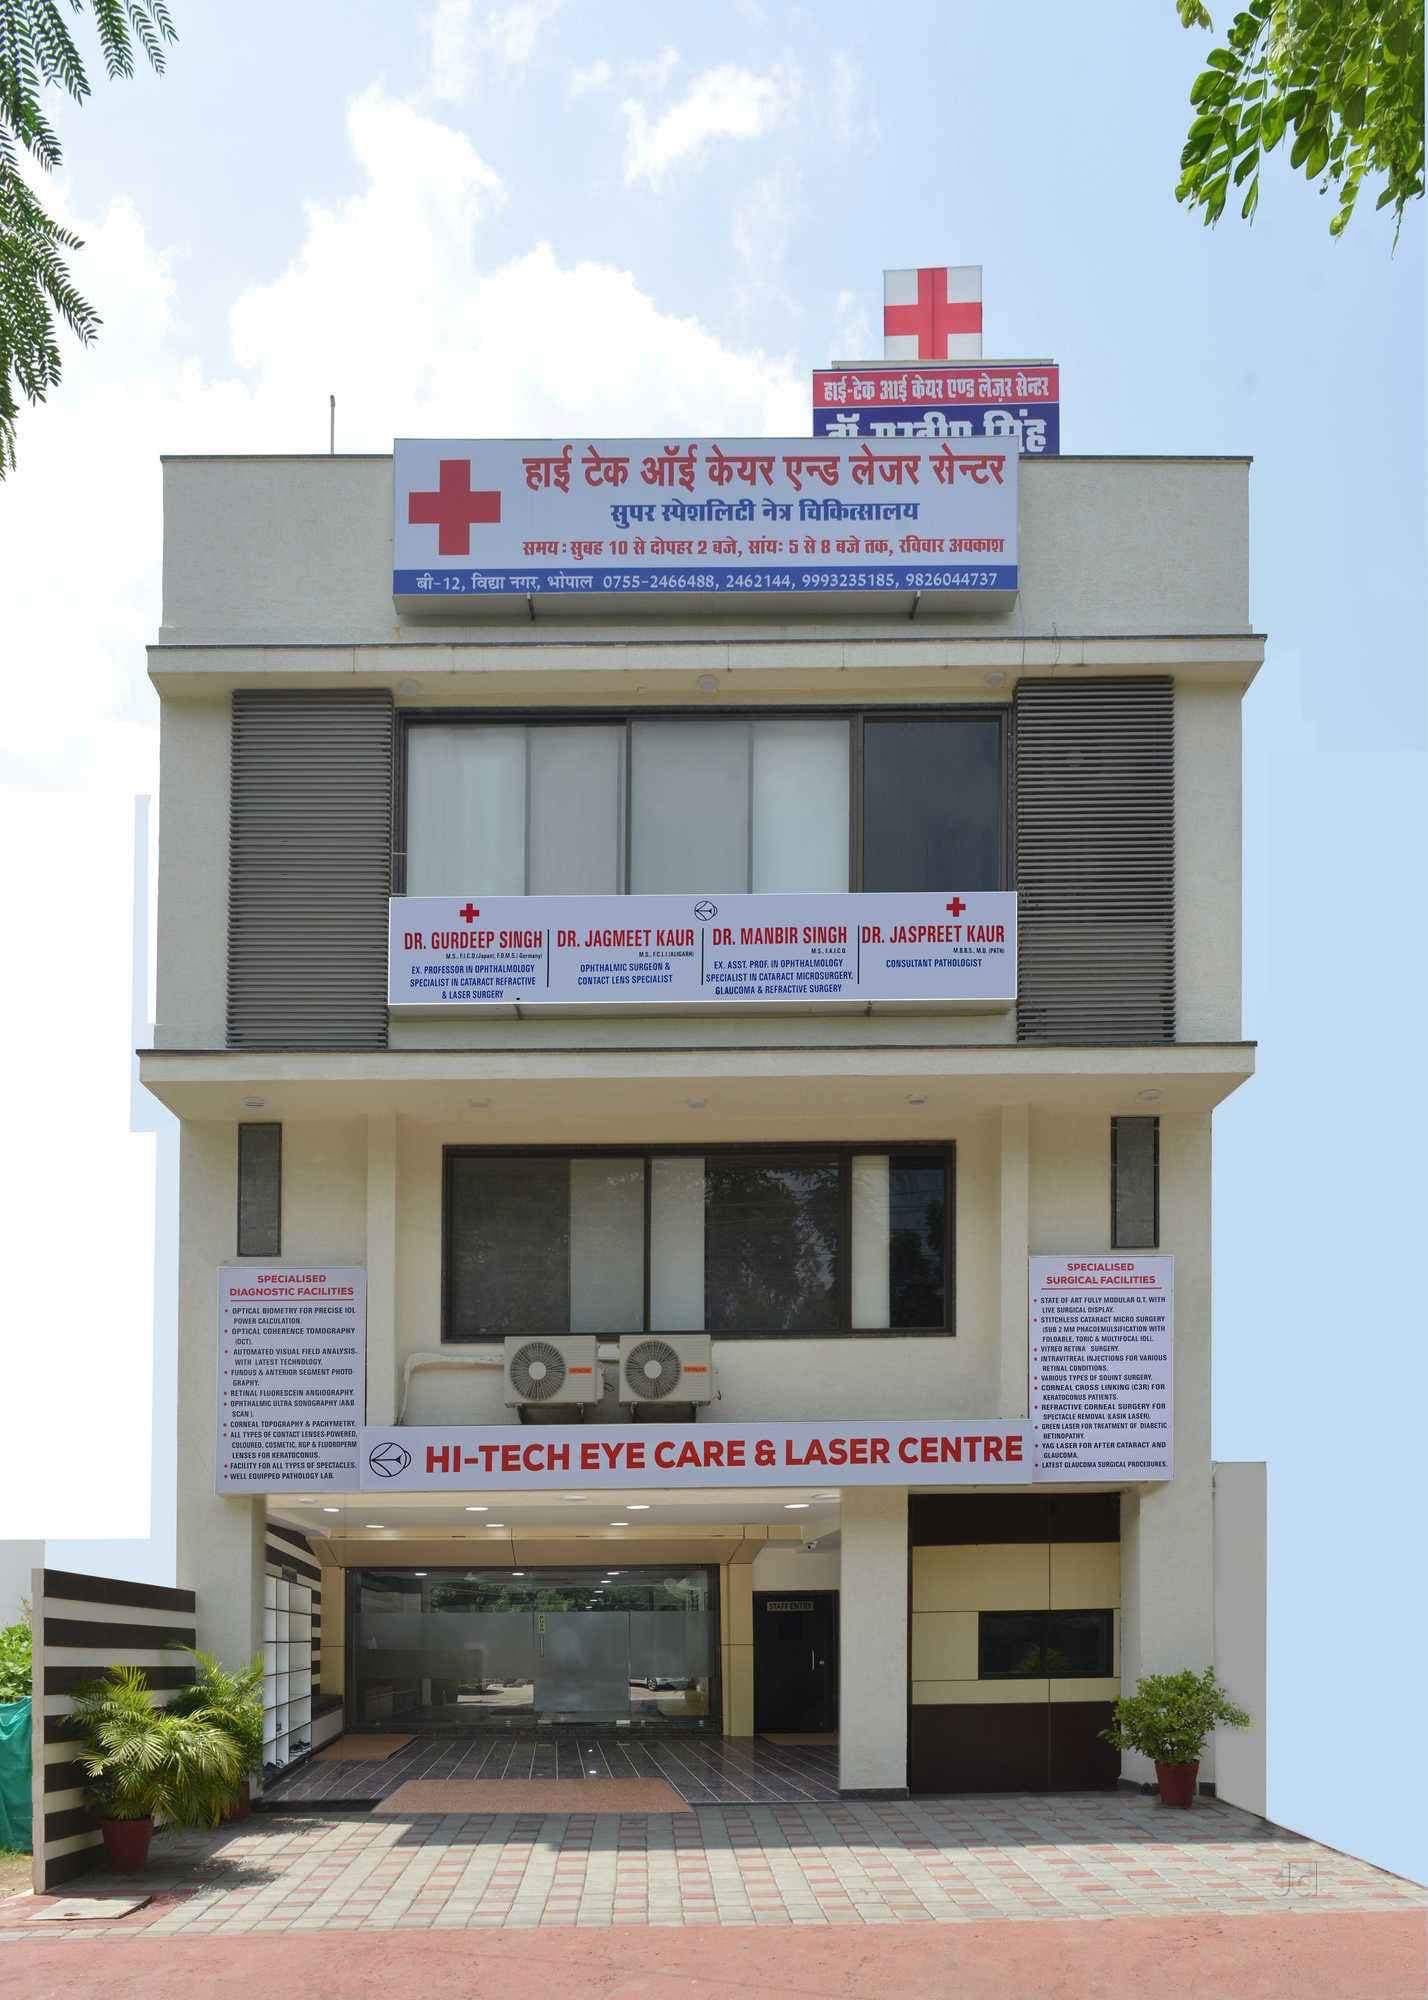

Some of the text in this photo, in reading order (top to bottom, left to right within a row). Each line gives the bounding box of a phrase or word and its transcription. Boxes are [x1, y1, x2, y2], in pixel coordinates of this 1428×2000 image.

[880, 375, 908, 401] आई
[911, 374, 944, 399] केयर
[1016, 373, 1049, 397] सेन्टर
[522, 442, 1006, 492] हाई टेक ऑई केयर एन्ड लेजर सेन्टर
[610, 498, 920, 528] सुपर स्पेशलिटी नेत्र चिकित्सालय
[570, 540, 602, 560] सुबह
[609, 540, 627, 555] 10
[633, 537, 645, 555] से
[650, 537, 694, 555] दोपहर
[698, 541, 708, 555] 2
[712, 536, 741, 557] बजे,
[789, 539, 798, 554] 5
[804, 536, 817, 554] से
[821, 540, 829, 554] 8
[836, 536, 860, 553] बजे
[865, 539, 893, 556] तक,
[900, 536, 944, 553] रविवार
[950, 538, 1004, 552] अवकाश
[471, 573, 505, 590] विद्या
[510, 576, 540, 590] नगर,
[547, 572, 592, 590] भोपाल
[727, 574, 796, 590] 2462144,
[906, 573, 998, 586] 9826044737
[404, 930, 542, 950] DR. GURDEEP SINGH
[558, 929, 694, 947] DR. JAGMEET KAUR
[712, 926, 847, 945] DR. MANBIR SINGH
[862, 926, 1004, 944] DR. JASPREET KAUR
[580, 962, 670, 972] OPHTHALMIC SURGEON &
[771, 960, 778, 968] IN
[781, 959, 843, 968] OPHTHALMOLOGY
[886, 958, 982, 968] CONSULTANT PATHOLOGIST
[424, 965, 464, 974] PROFESSOR
[466, 965, 473, 973] IN
[475, 964, 534, 974] OPHTHALMOLOGY
[410, 977, 536, 987] SPECIALIST IN CATARACT REFRACTIVE
[578, 975, 672, 985] CONTACT LENS SPECIALIST
[706, 974, 748, 982] SPECIALIST
[750, 973, 757, 982] IN
[759, 972, 794, 981] CATARACT
[715, 984, 842, 994] GLAUCOMA & REFRACTIVE SURGERY
[442, 990, 503, 999] & LASER SURGERY
[1067, 1263, 1134, 1272] SPECIALISED
[257, 1274, 326, 1283] SPECIALISED
[1046, 1276, 1155, 1285] SURGICAL FACILITIES
[230, 1287, 353, 1296] DIAGNOSTIC FACILITIES
[425, 1434, 1023, 1473] HI-TECH EYE CARE & LASER CENTRE
